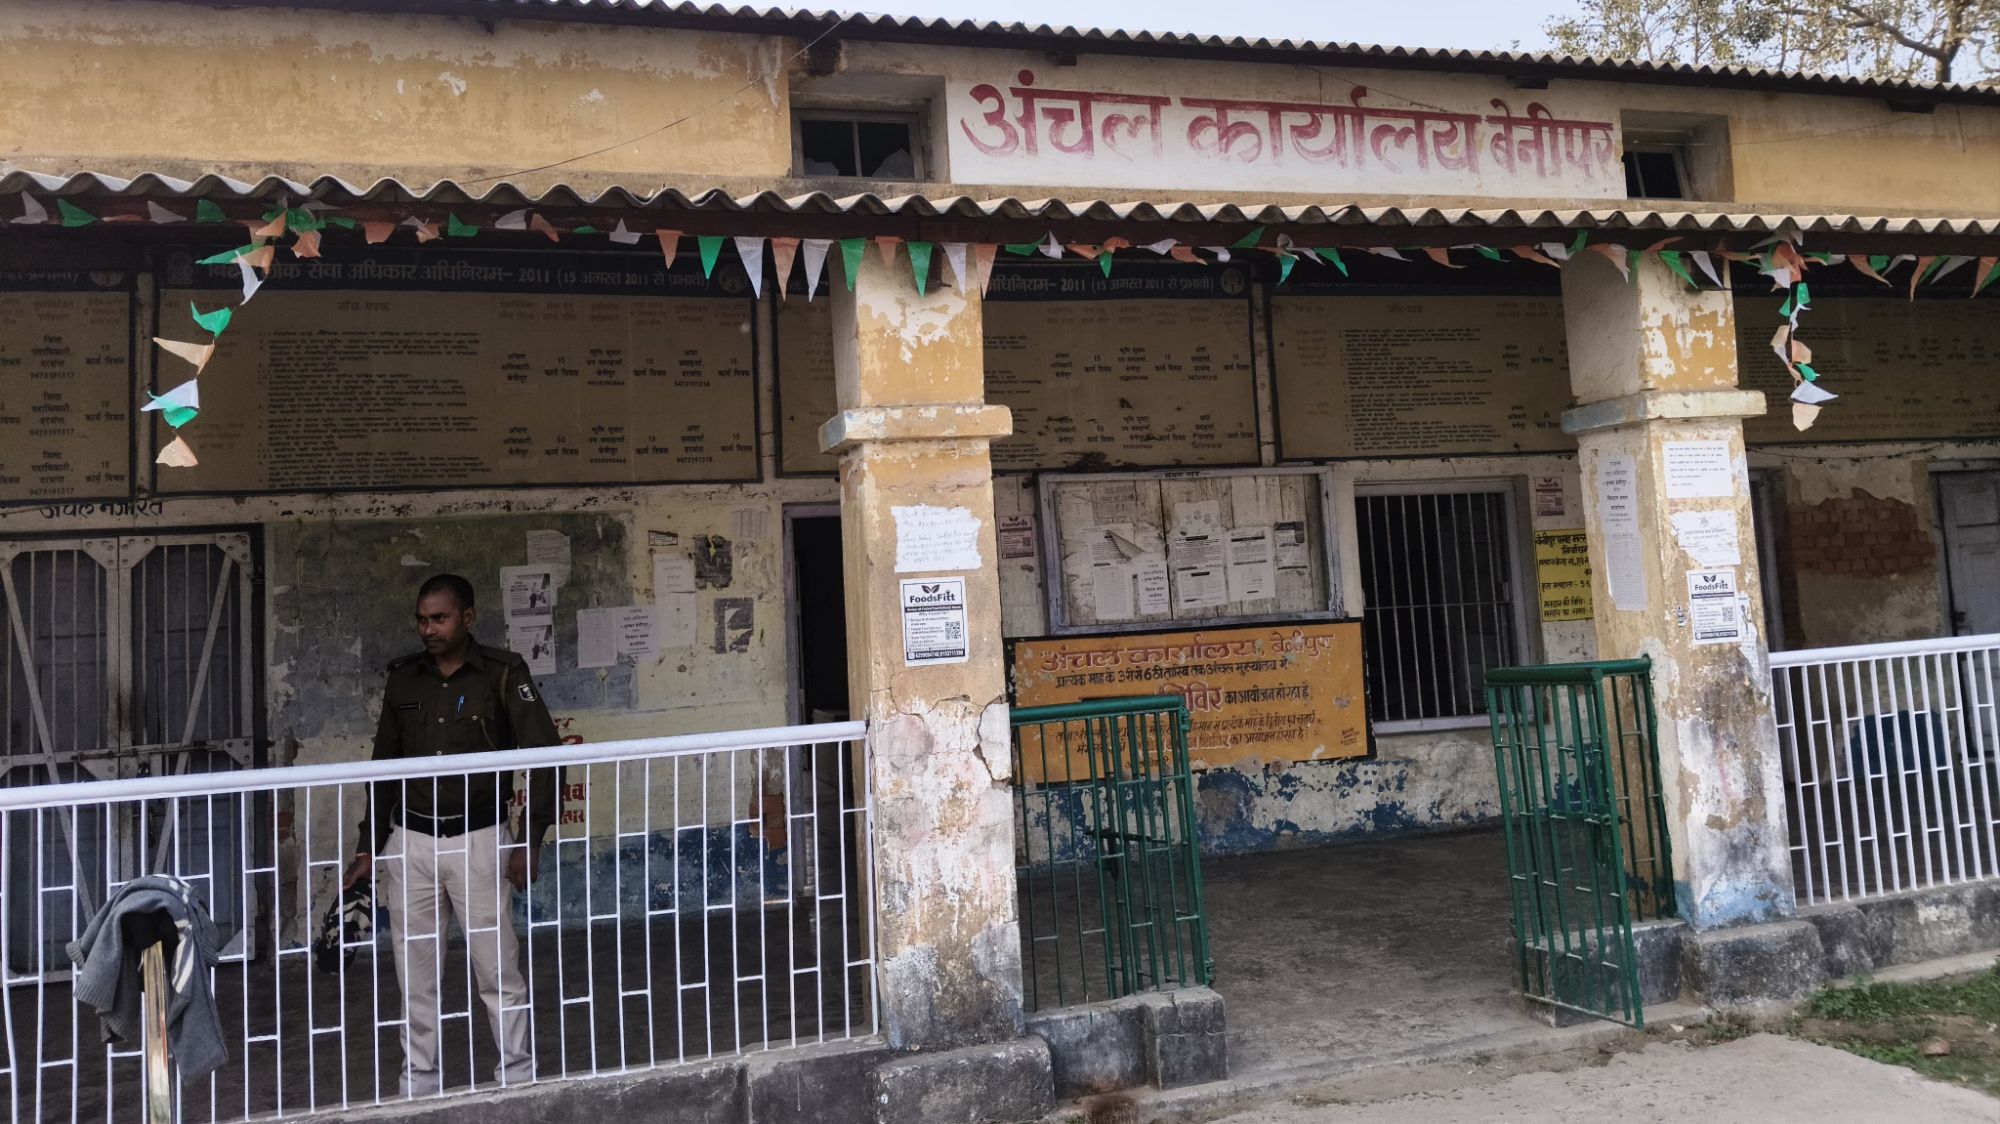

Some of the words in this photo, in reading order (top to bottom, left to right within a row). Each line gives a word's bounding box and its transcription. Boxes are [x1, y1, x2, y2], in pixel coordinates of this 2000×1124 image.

[961, 69, 1171, 163] अंचल
[1180, 84, 1484, 176] कार्यालय
[306, 257, 343, 280] सेवा
[346, 257, 418, 283] अधिकार
[518, 266, 551, 284] 2011
[580, 269, 621, 287] अगस्त
[624, 271, 649, 286] 2011
[653, 269, 666, 288] से
[1060, 277, 1087, 292] 2011
[1110, 278, 1142, 292] अगस्त
[1145, 277, 1164, 291] 2011
[1168, 276, 1179, 291] से
[1694, 580, 1729, 591] FoodsFitt
[910, 589, 956, 604] FoodsFitt
[1040, 644, 1124, 673] अंचल
[1055, 669, 1086, 688] प्रत्येक
